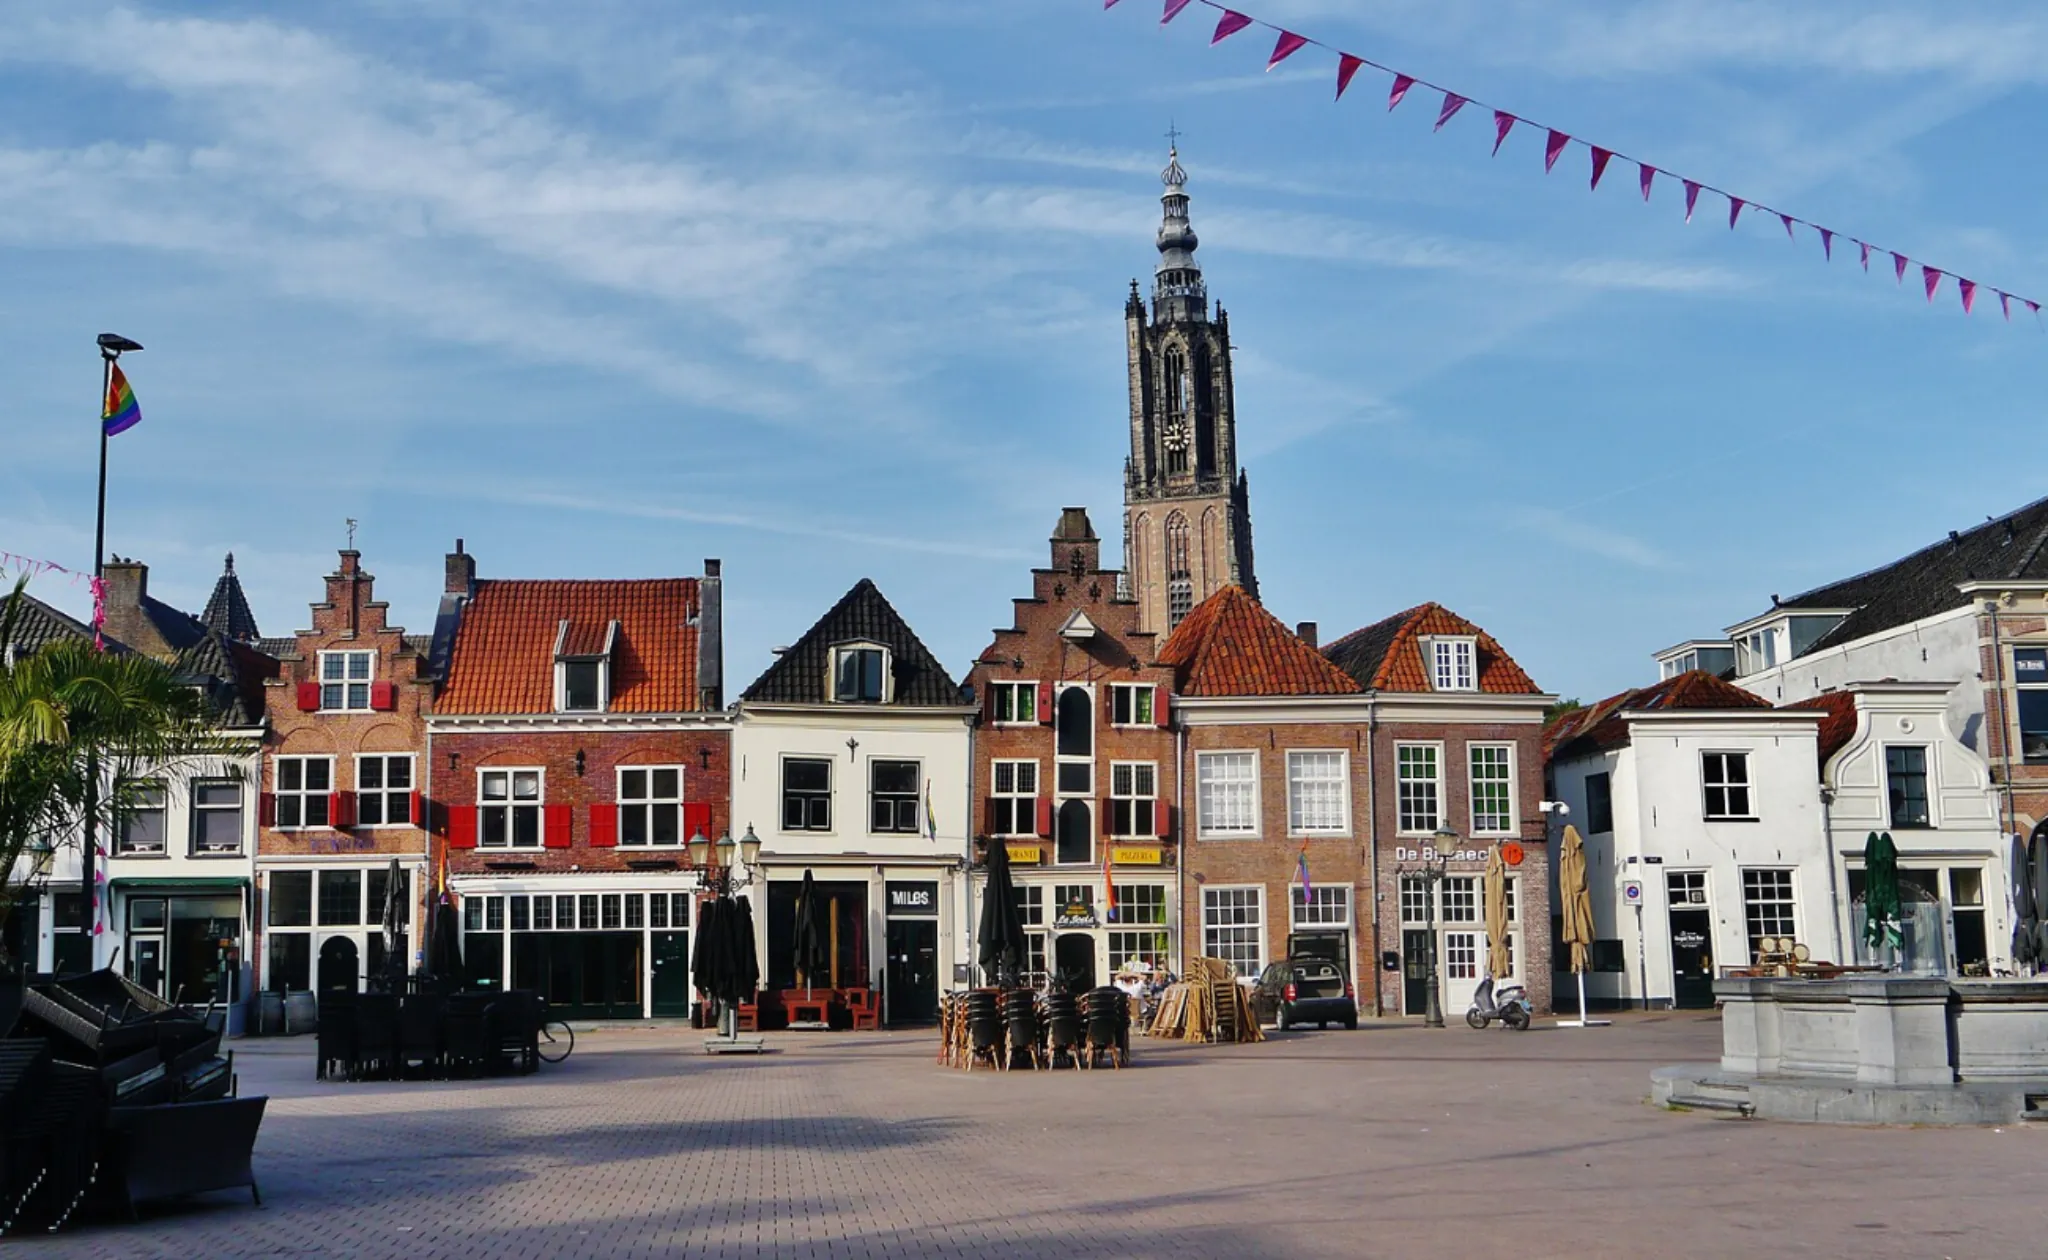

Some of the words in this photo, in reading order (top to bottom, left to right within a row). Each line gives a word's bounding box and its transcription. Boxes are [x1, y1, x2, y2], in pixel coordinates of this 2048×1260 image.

[1120, 851, 1153, 861] PIZZERIA
[1395, 846, 1417, 861] De
[1422, 846, 1492, 864] Bijaec
